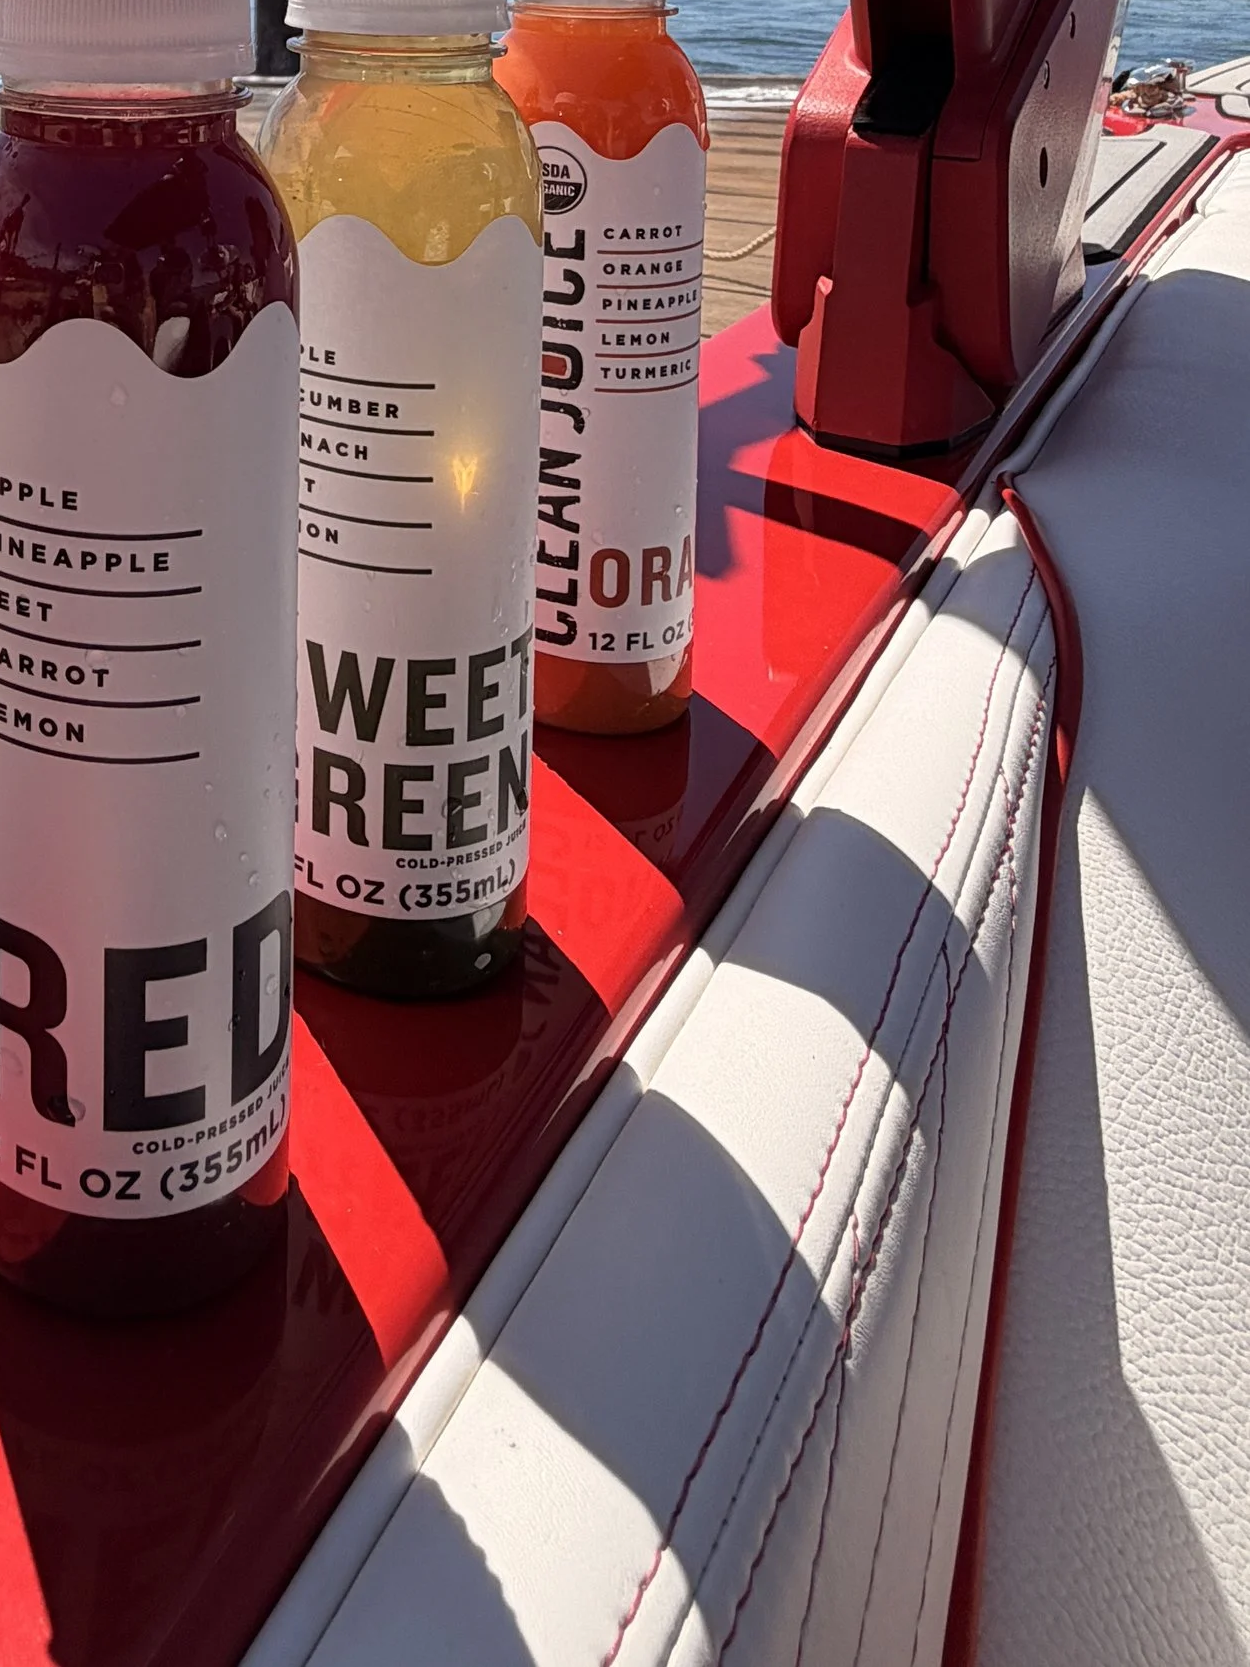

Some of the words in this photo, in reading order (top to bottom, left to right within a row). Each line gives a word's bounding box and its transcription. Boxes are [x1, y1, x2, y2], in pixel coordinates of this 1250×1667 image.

[603, 224, 683, 240] CARROT
[603, 259, 684, 276] ORANGE
[602, 289, 698, 312] PINEAPPLE
[540, 228, 586, 436] JUICE
[601, 331, 671, 346] LEMON
[600, 358, 692, 380] TURMERIC
[535, 446, 582, 647] CLEAN
[588, 632, 616, 652] 12
[626, 632, 655, 652] FL
[662, 619, 685, 646] OZ
[295, 730, 529, 852] REEN
[396, 841, 503, 870] COLD-PRESSED
[336, 874, 385, 906] OZ
[399, 858, 516, 913] (355mL)
[132, 1095, 263, 1155] COLD-PRESSED
[15, 1146, 63, 1192] FL
[79, 1168, 142, 1201] OZ
[160, 1093, 286, 1202] (355mL)
